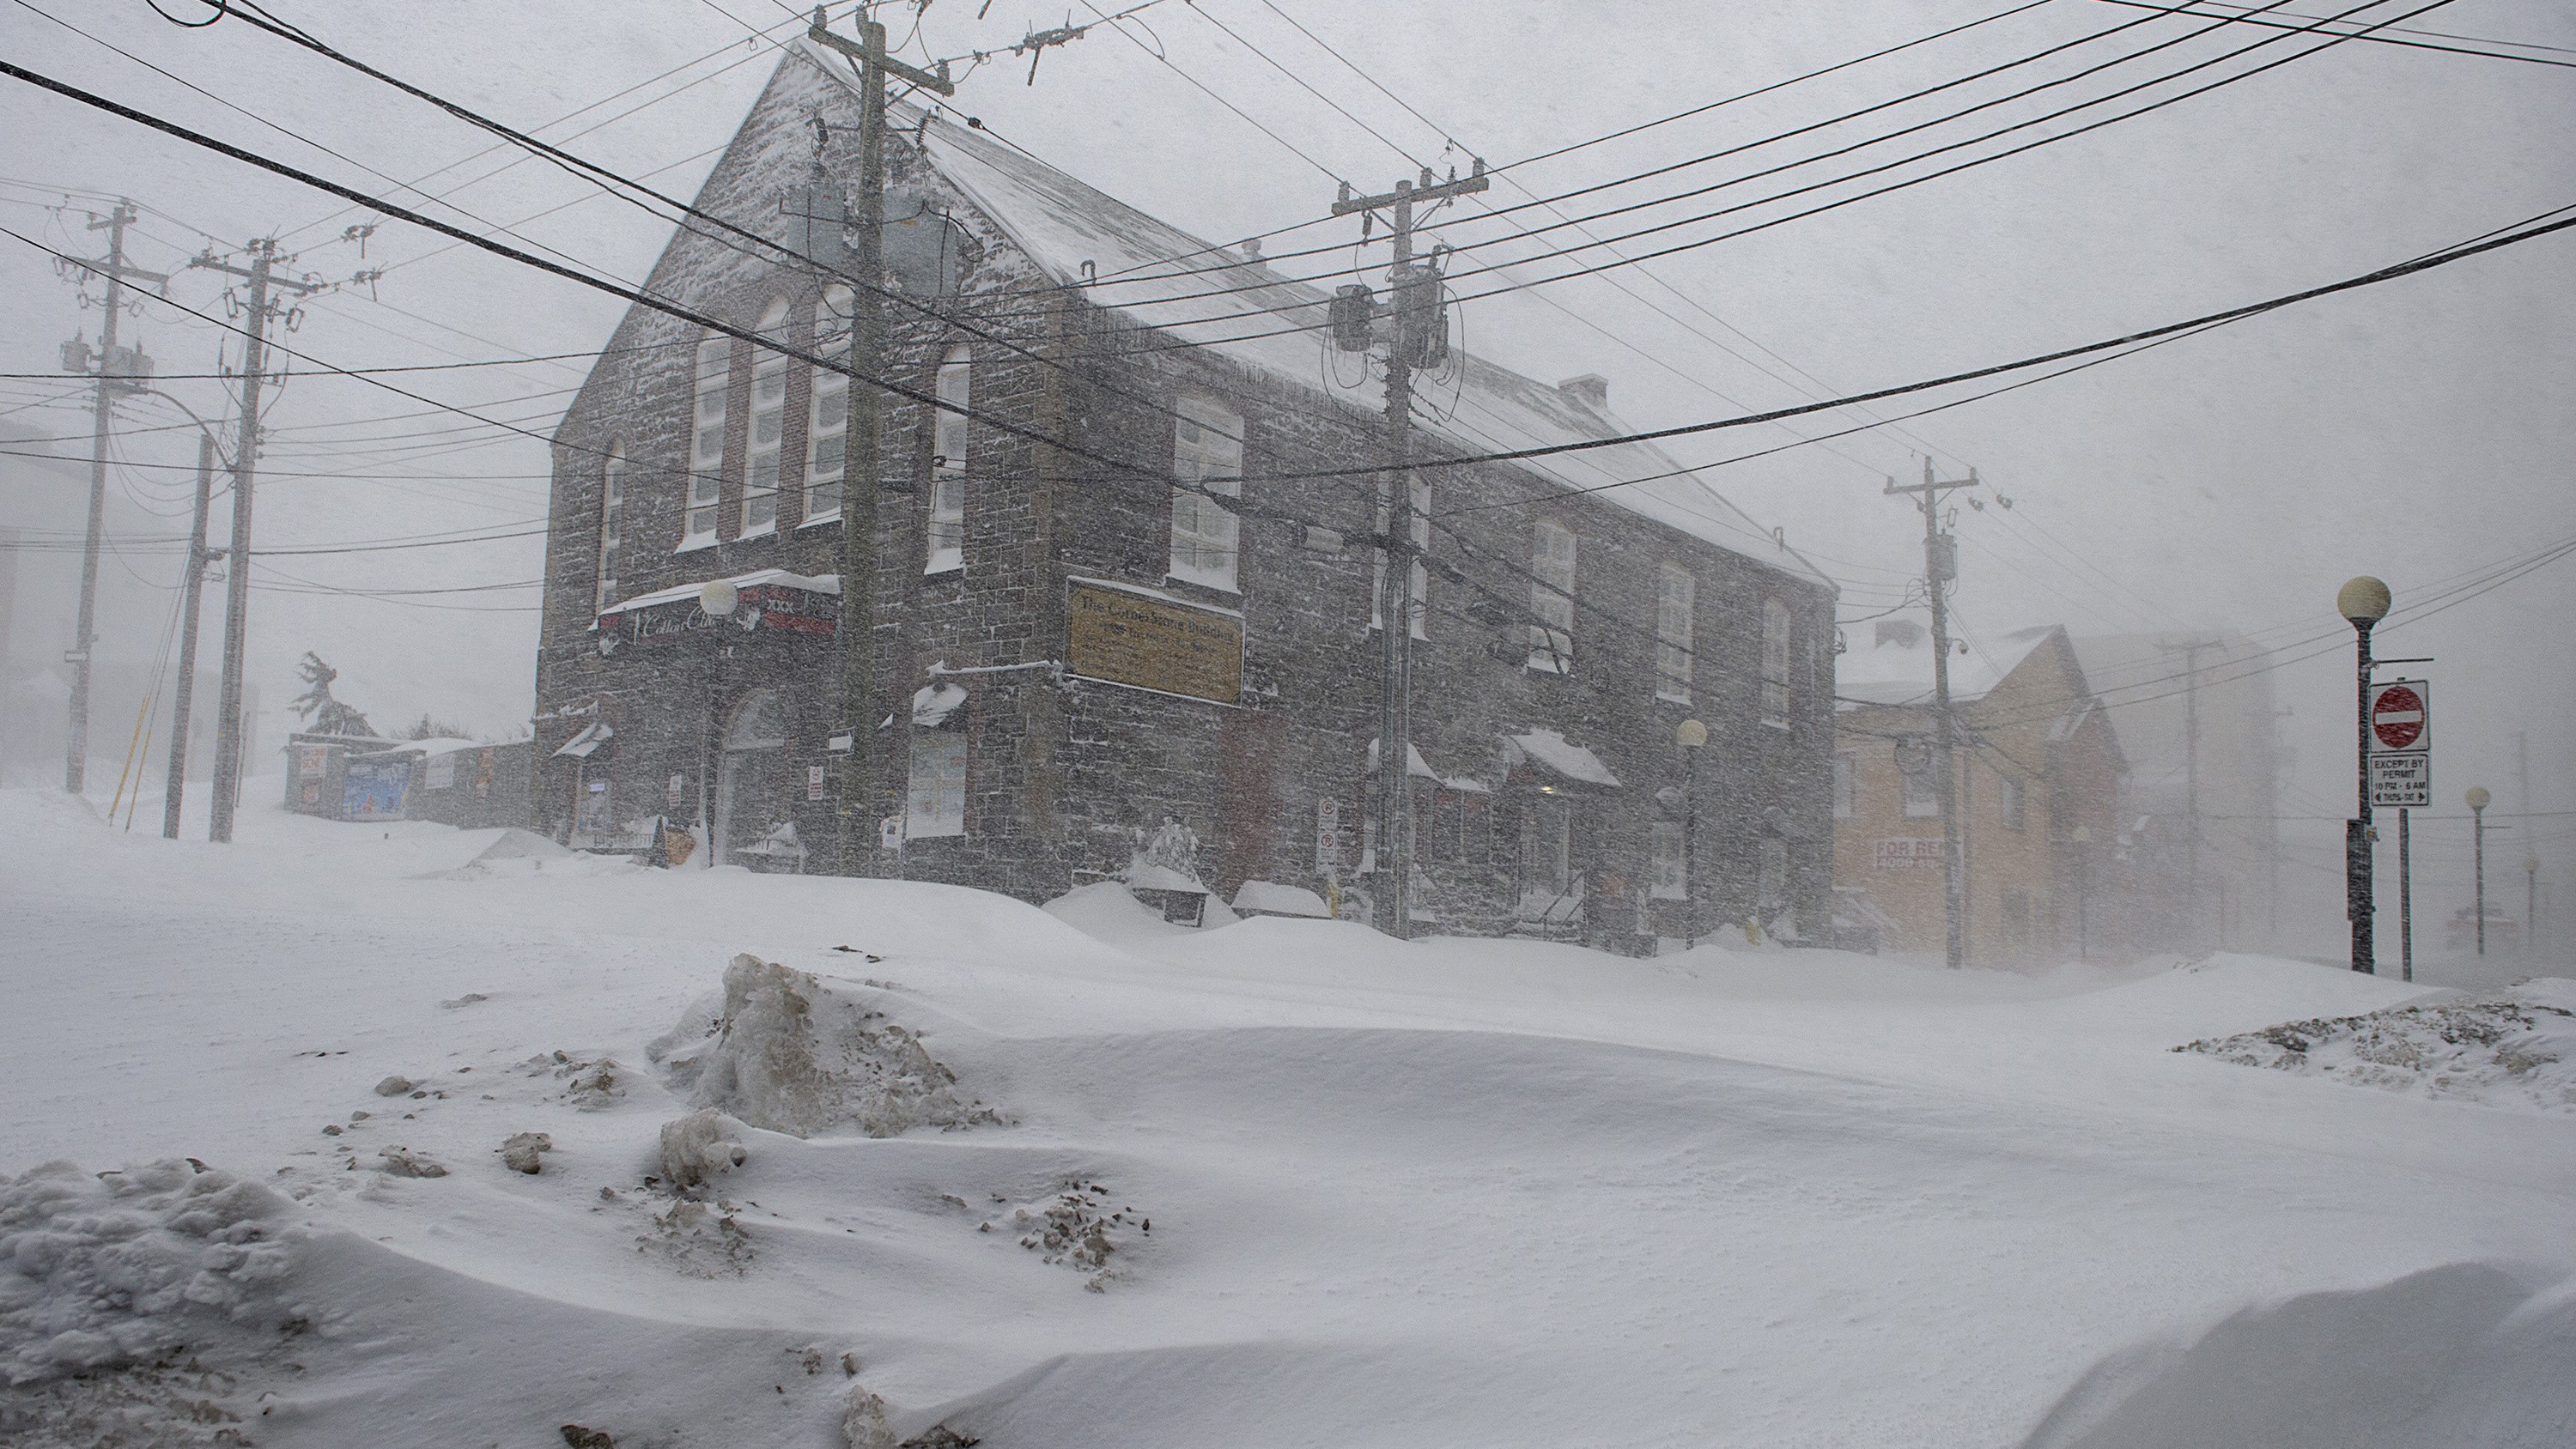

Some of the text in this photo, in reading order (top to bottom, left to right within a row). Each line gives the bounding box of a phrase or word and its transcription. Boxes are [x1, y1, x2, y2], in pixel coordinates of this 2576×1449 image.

[1082, 596, 1104, 612] The
[2374, 759, 2424, 768] EXCEPT BY
[2383, 769, 2415, 779] PERMIT
[1877, 841, 1910, 855] FOR
